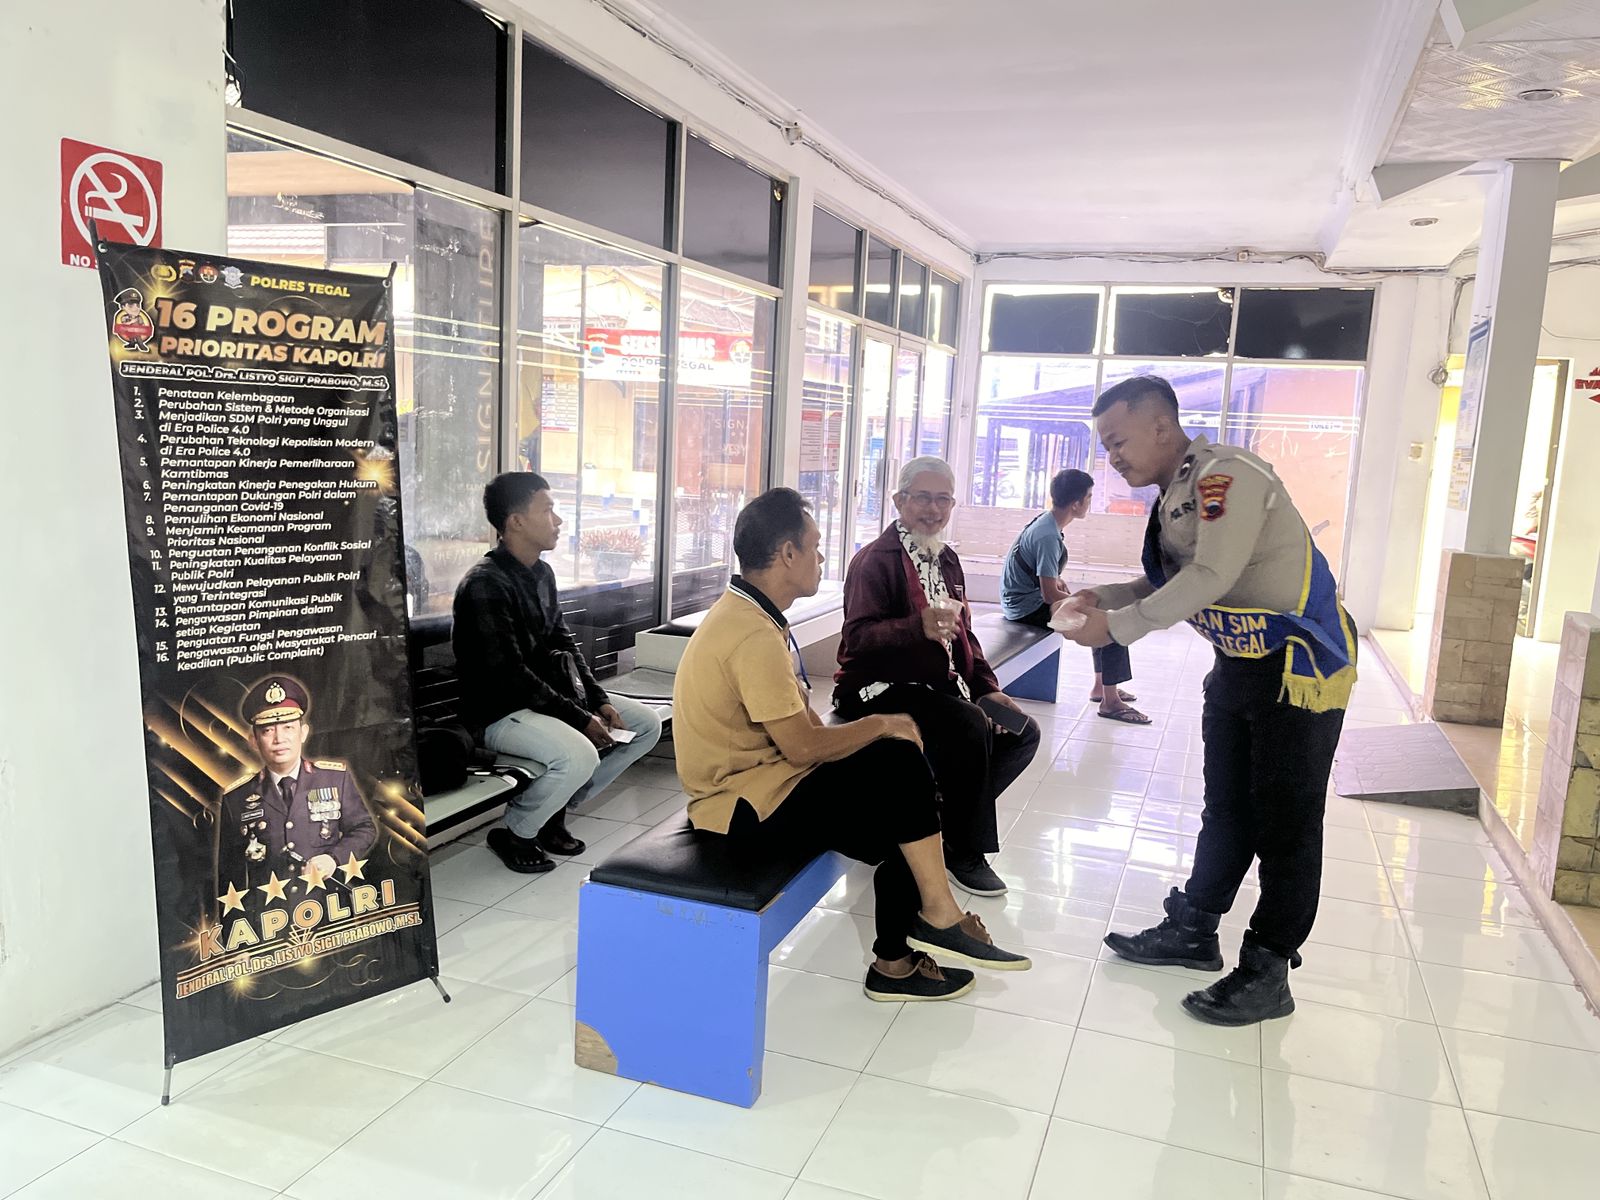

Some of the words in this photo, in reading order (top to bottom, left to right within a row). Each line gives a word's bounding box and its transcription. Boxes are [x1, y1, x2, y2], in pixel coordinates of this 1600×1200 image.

[70, 254, 91, 267] NO
[250, 275, 305, 293] POLRES
[308, 282, 351, 298] TEGAL
[156, 299, 197, 330] 16
[205, 305, 387, 345] PROGRAM
[160, 336, 288, 363] PRIORITAS
[291, 346, 387, 369] KAPOLRI
[122, 364, 183, 376] JENDERAL
[186, 368, 213, 378] POL.
[214, 370, 237, 379] Drs.
[239, 371, 276, 381] LISTYO
[278, 373, 306, 384] SIGIT
[307, 376, 360, 387] PRABOWO,
[134, 386, 142, 396] 1.
[158, 387, 214, 399] Penataan
[216, 390, 294, 403] Kelembagaan
[134, 398, 144, 408] 2.
[158, 399, 222, 410] Perubahan
[224, 402, 262, 412] Sistem
[264, 403, 272, 412] &
[274, 404, 315, 414] Metode
[316, 405, 369, 417] Organisasi
[134, 410, 144, 420] 3.
[158, 410, 226, 423] Menjadikan
[228, 413, 255, 423] SDM
[256, 414, 282, 424] Polri
[283, 416, 311, 427] yang
[312, 416, 348, 428] Unggul
[158, 422, 171, 431] di
[174, 422, 193, 432] Era
[196, 423, 229, 433] Police
[231, 424, 250, 433] 4.0
[138, 434, 148, 444] 4.
[160, 434, 224, 444] Perubahan
[228, 435, 279, 447] Teknologi
[281, 436, 332, 448] Kepolisian
[335, 437, 374, 447] Modern
[159, 445, 172, 454] di
[175, 445, 196, 455] Era
[197, 446, 231, 455] Police
[232, 446, 251, 455] 4.0
[140, 456, 148, 466] 5.
[160, 457, 236, 468] Pemantapan
[238, 458, 277, 469] Kinerja
[160, 468, 229, 478] Kamtibmas
[142, 480, 152, 490] 6.
[161, 480, 236, 491] Peningkatan
[238, 480, 277, 491] Kinerja
[278, 479, 337, 490] Penegakan
[338, 479, 376, 488] Hukum
[144, 492, 152, 502] 7.
[162, 492, 238, 502] Pemantapan
[240, 491, 296, 501] Dukungan
[298, 489, 321, 499] Polri
[323, 489, 356, 498] dalam
[163, 504, 238, 514] Penanganan
[240, 500, 284, 511] Covid-19
[146, 514, 154, 524] 8.
[164, 515, 228, 524] Pemulihan
[229, 512, 277, 522] Ekonomi
[278, 511, 324, 521] Nasional
[146, 526, 156, 536] 9.
[165, 526, 224, 536] Menjamin
[226, 524, 284, 533] Keamanan
[286, 522, 331, 533] Program
[167, 537, 215, 546] Prioritas
[218, 534, 265, 544] Nasional
[150, 550, 162, 560] 10.
[168, 548, 232, 559] Penguatan
[234, 544, 302, 555] Penanganan
[303, 540, 339, 551] Konflik
[340, 539, 372, 549] Sosial
[152, 562, 162, 570] 11.
[169, 558, 242, 570] Peningkatan
[243, 556, 287, 565] Kualitas
[288, 553, 342, 564] Pelayanan
[154, 584, 166, 594] 12.
[172, 580, 244, 592] Mewujudkan
[245, 576, 301, 587] Pelayanan
[302, 572, 336, 583] Publik
[336, 570, 360, 580] Polri
[170, 569, 205, 580] Publik
[207, 568, 234, 578] Polri
[154, 606, 168, 616] 13.
[174, 601, 246, 615] Pemantapan
[248, 594, 309, 608] Komunikasi
[310, 591, 342, 603] Publik
[173, 594, 198, 604] yang
[201, 588, 267, 601] Terintegrasi
[154, 618, 170, 628] 14.
[175, 612, 246, 625] Pengawasan
[248, 608, 298, 619] Pimpinan
[300, 605, 333, 615] dalam
[1228, 614, 1268, 635] SIM
[156, 640, 168, 652] 15.
[176, 635, 235, 648] Penguatan
[238, 629, 275, 642] Fungsi
[276, 624, 343, 638] Pengawasan
[175, 627, 206, 638] setiap
[208, 622, 261, 634] Kegiatan
[156, 652, 170, 662] 16.
[176, 645, 247, 659] Pengawasan
[249, 640, 273, 652] oleh
[275, 634, 335, 649] Masyarakat
[337, 629, 377, 642] Pencari
[1216, 632, 1270, 654] TEGAL
[177, 658, 224, 670] Keadilan
[226, 653, 265, 665] (Public
[266, 645, 324, 660] Complaint)
[199, 878, 397, 961] KAPOLRI
[177, 967, 226, 999] JENDERAL
[226, 961, 252, 980] POL.
[251, 955, 275, 973] Drs.
[275, 942, 314, 965] LISTYO
[313, 933, 342, 954] SIGIT
